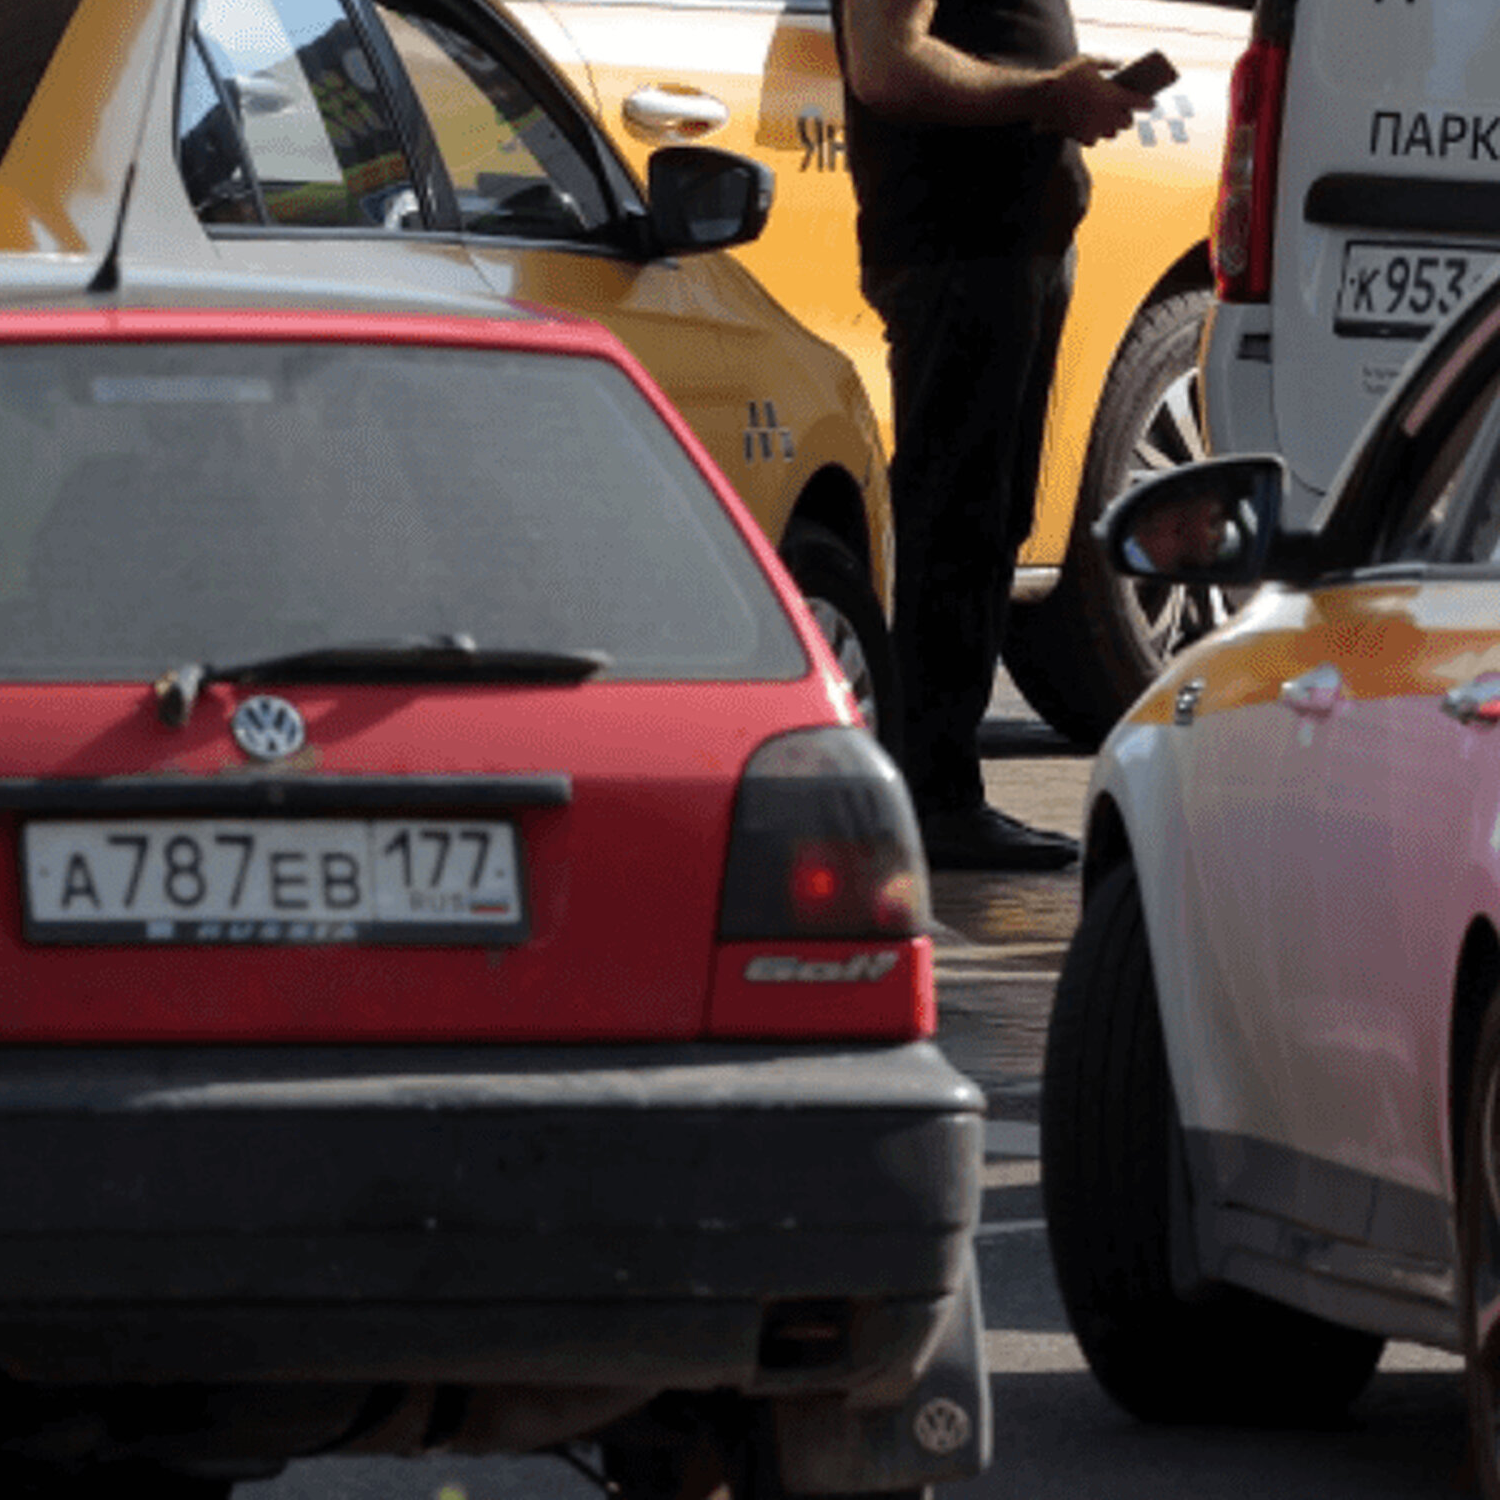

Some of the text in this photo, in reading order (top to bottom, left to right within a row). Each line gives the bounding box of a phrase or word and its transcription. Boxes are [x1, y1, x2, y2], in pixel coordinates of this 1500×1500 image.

[1370, 111, 1500, 160] ПАРК
[1354, 257, 1482, 315] К953
[384, 829, 492, 891] 177
